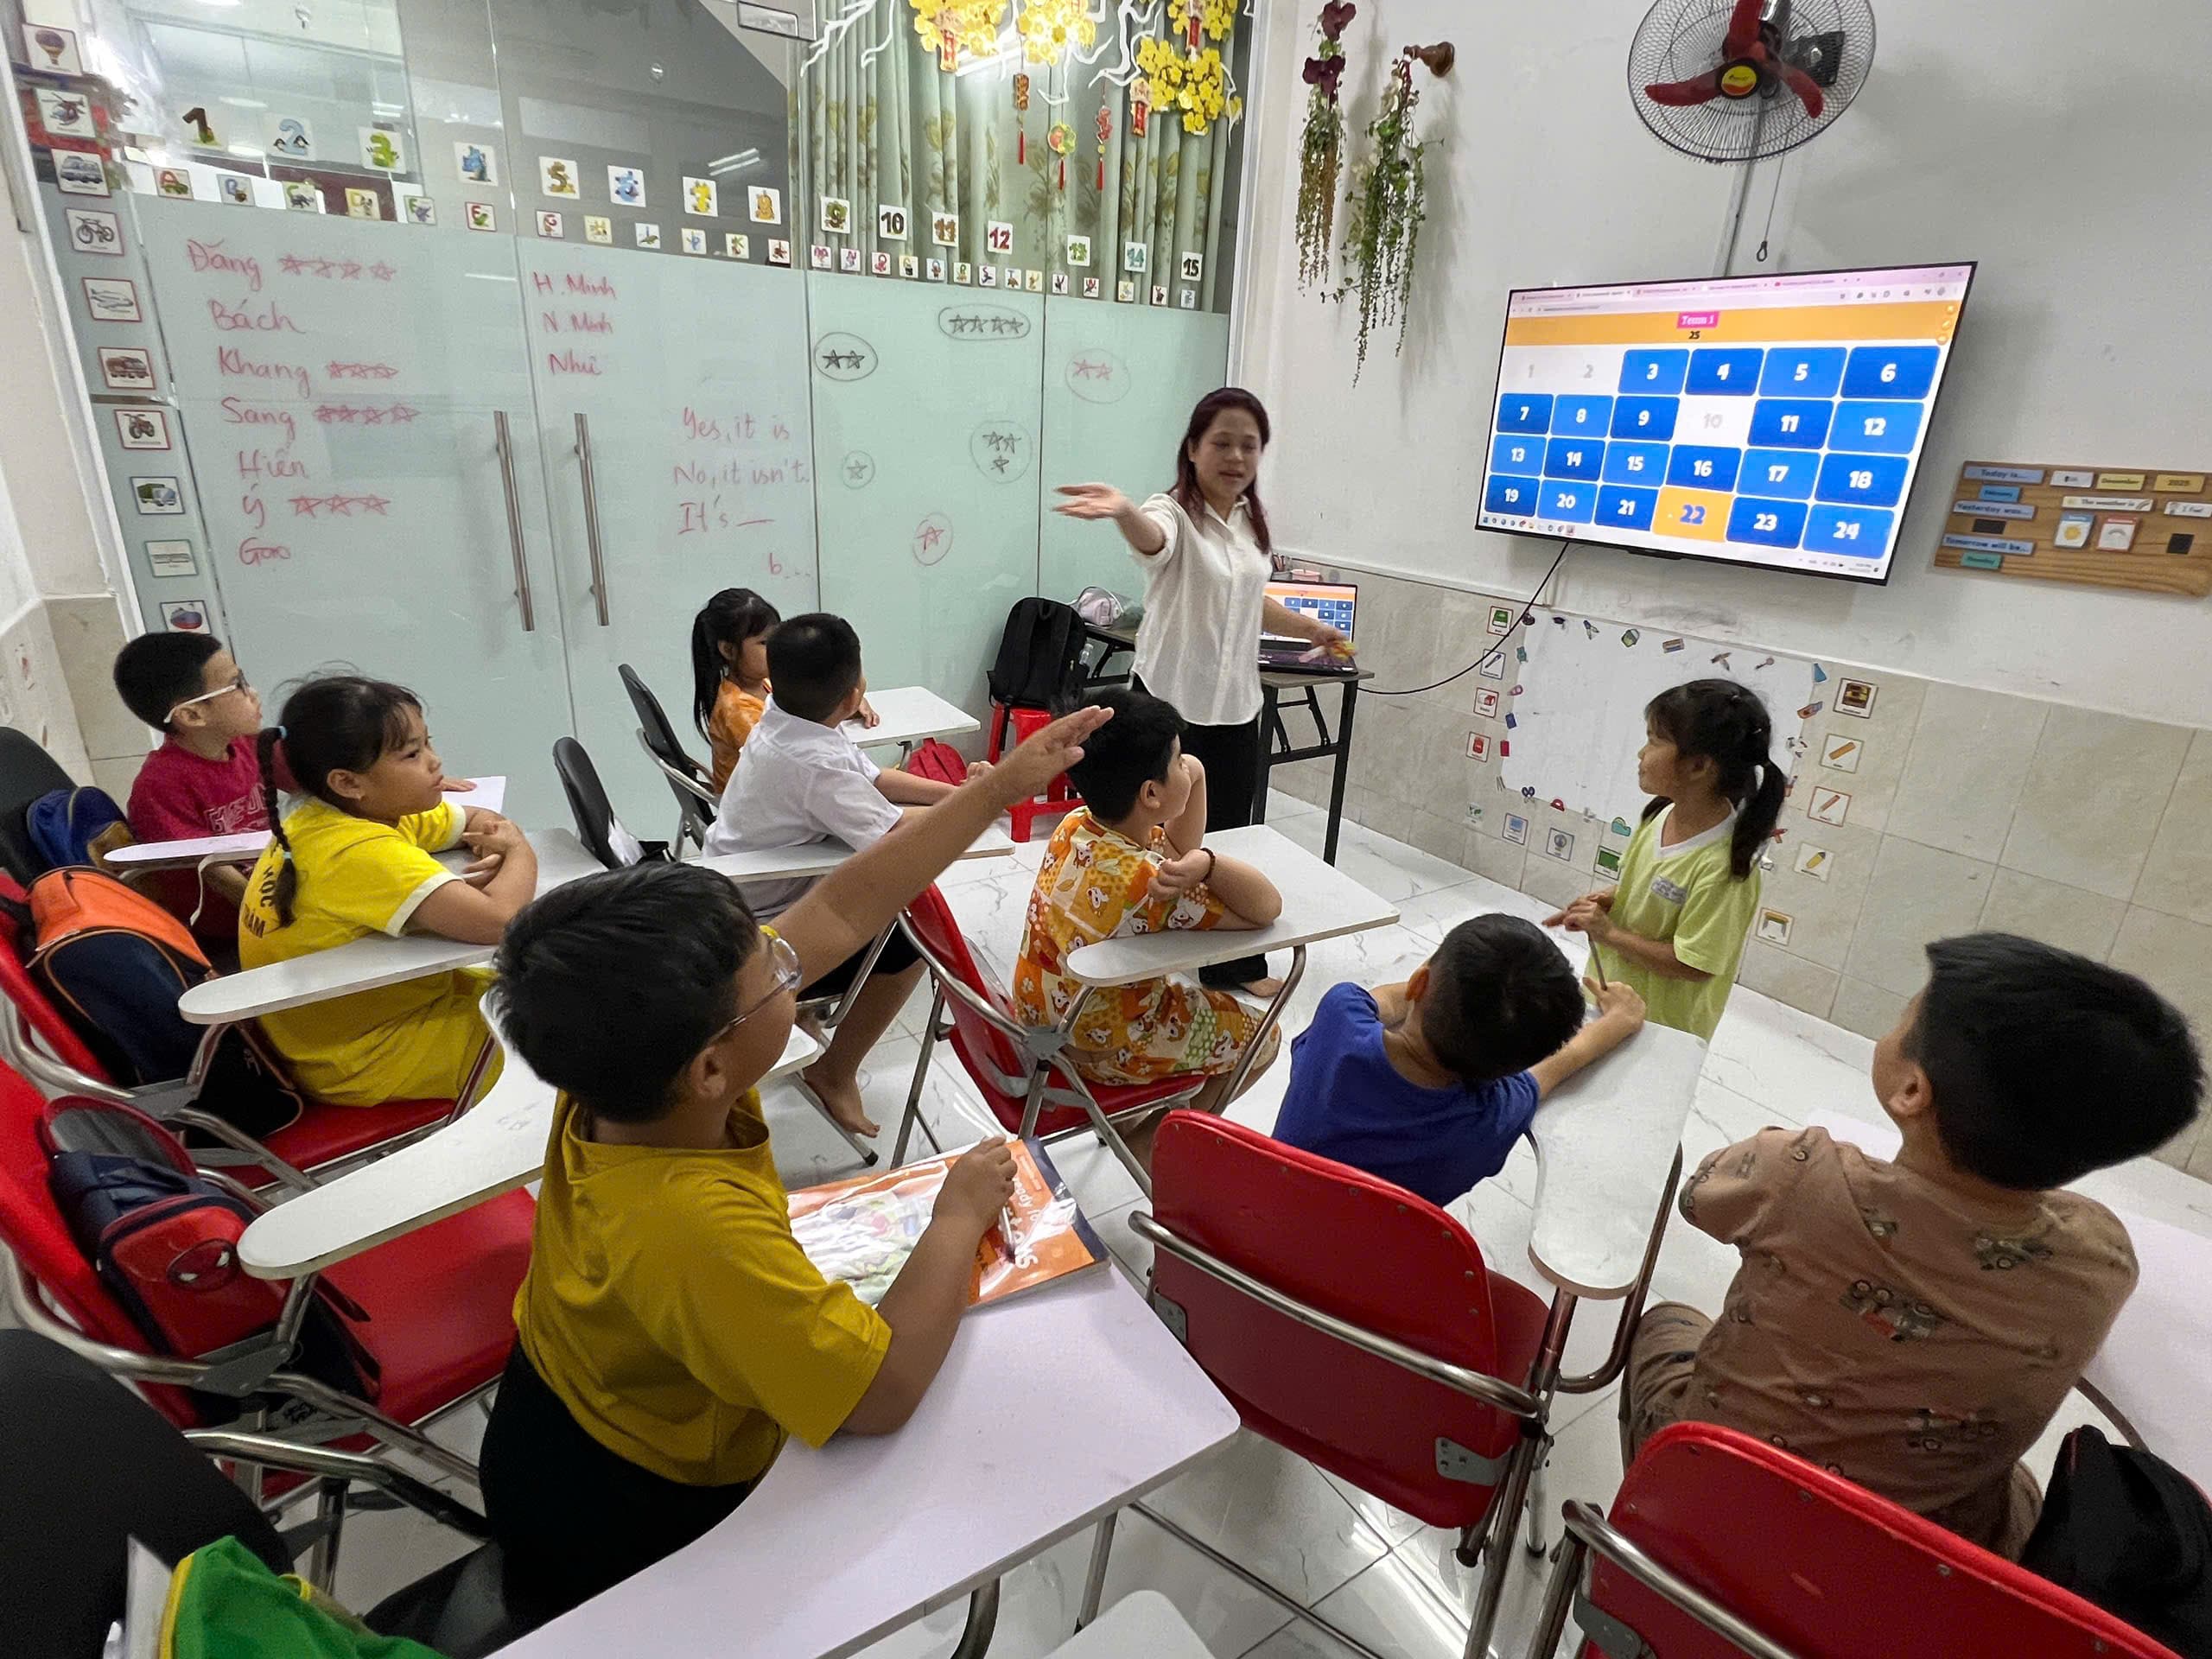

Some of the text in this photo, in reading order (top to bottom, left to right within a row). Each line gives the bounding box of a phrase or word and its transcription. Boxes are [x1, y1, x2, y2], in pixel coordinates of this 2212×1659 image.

[182, 107, 208, 143] 1
[370, 132, 396, 168] 3
[880, 212, 905, 234] 10
[934, 218, 957, 242] 11
[989, 226, 1011, 250] 12
[1183, 257, 1199, 276] 15
[207, 298, 306, 334] Bách
[1681, 315, 1707, 326] Team
[1688, 330, 1700, 340] 25
[219, 345, 310, 399] Khang
[1528, 364, 1535, 378] 1
[1584, 364, 1593, 378] 2
[1646, 363, 1659, 380] 3
[1716, 363, 1731, 381] 4
[1794, 363, 1808, 382] 5
[1880, 363, 1897, 383] 6
[221, 397, 296, 441] Sang
[1520, 406, 1529, 421] 7
[1575, 408, 1587, 423] 8
[1638, 410, 1650, 426] 9
[1703, 413, 1723, 429] 10
[1781, 415, 1800, 433] 11
[1864, 417, 1887, 436] 12
[1511, 447, 1526, 462] 13
[1566, 451, 1582, 467] 14
[1627, 455, 1644, 472] 15
[723, 459, 741, 484] it
[1694, 460, 1713, 477] 16
[1768, 465, 1789, 483] 17
[1849, 470, 1873, 489] 18
[1504, 488, 1519, 503] 19
[1556, 493, 1577, 509] 20
[1618, 499, 1636, 516] 21
[1680, 504, 1706, 525] 22
[1753, 513, 1778, 531] 23
[1833, 521, 1860, 540] 24
